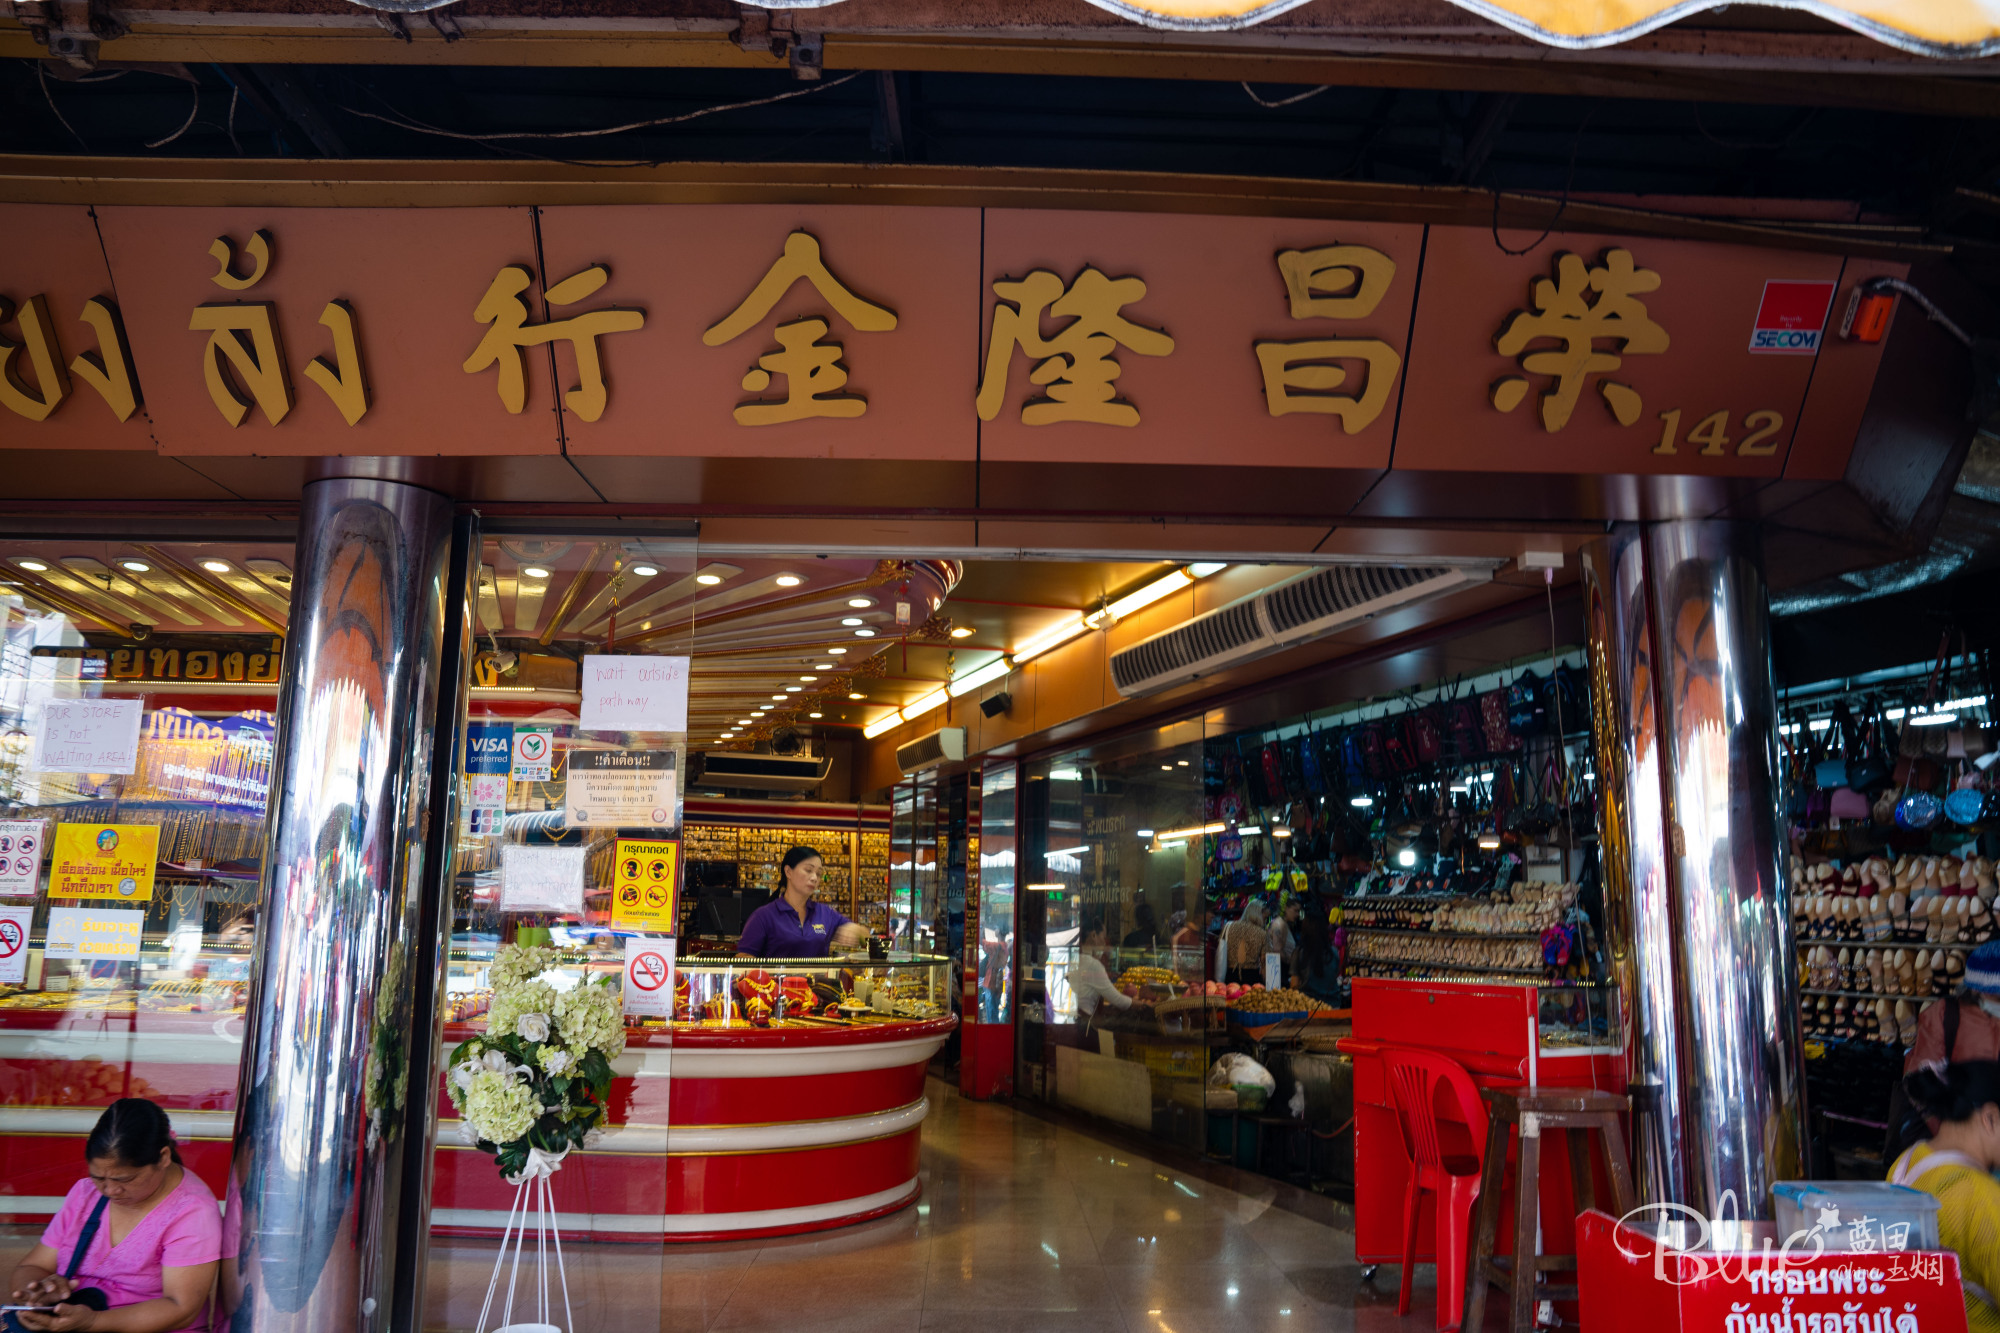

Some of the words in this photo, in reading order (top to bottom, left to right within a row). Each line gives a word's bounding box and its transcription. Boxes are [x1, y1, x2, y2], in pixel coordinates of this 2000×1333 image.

[1755, 330, 1817, 348] SECOM
[1653, 408, 1784, 457] 142
[596, 662, 628, 682] wait
[639, 661, 680, 682] outside
[46, 706, 71, 719] OUR
[82, 705, 123, 719] STORE
[47, 726, 58, 740] is
[470, 738, 508, 752] VISA
[471, 755, 508, 764] preferred
[471, 817, 502, 826] JCB
[624, 844, 669, 856] กรุณาถอด
[58, 860, 106, 876] เดือดร้อน
[61, 877, 113, 894] นึกถึงเรา
[1749, 1268, 1887, 1295] กรอบพระ
